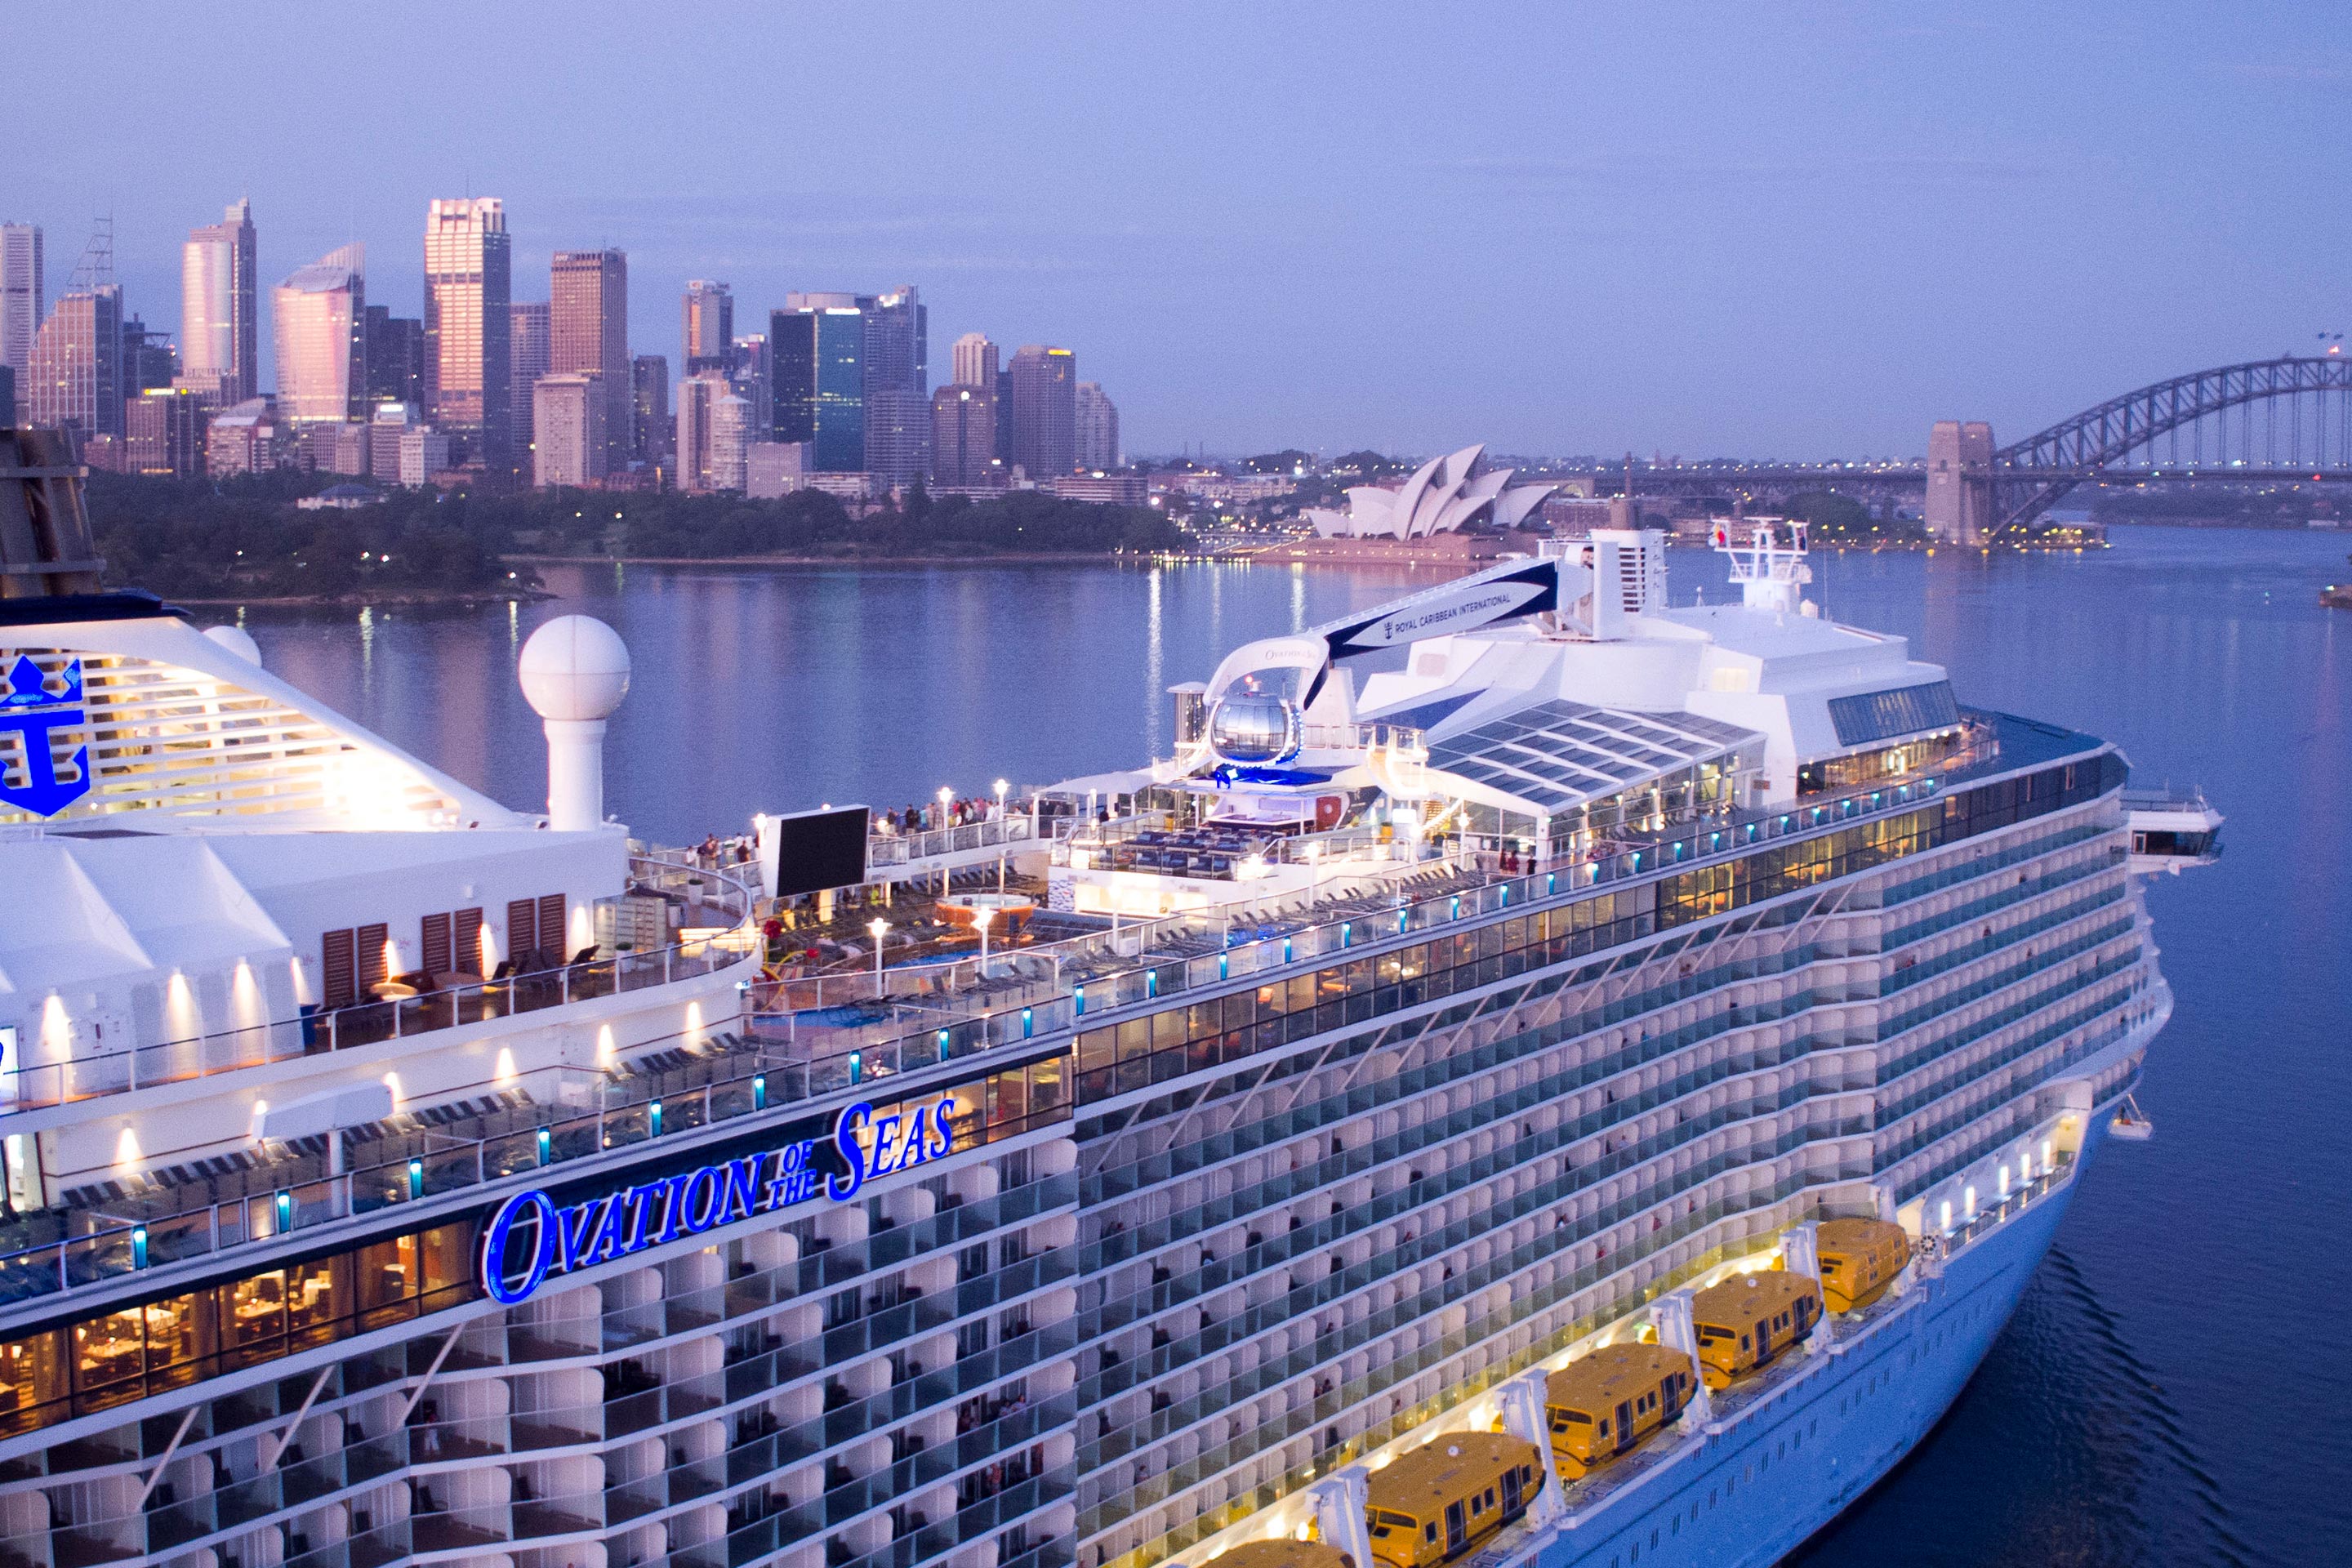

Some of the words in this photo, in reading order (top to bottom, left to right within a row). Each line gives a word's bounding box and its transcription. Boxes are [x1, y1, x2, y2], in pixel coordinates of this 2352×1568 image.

[1395, 620, 1417, 633] ROYAL
[1419, 608, 1458, 626] CARIBBEAN
[1459, 594, 1511, 615] INTERNATIONAL
[783, 1140, 814, 1174] OF
[827, 1098, 956, 1202] SEAS
[770, 1170, 816, 1208] THE
[483, 1152, 767, 1304] OVATION
